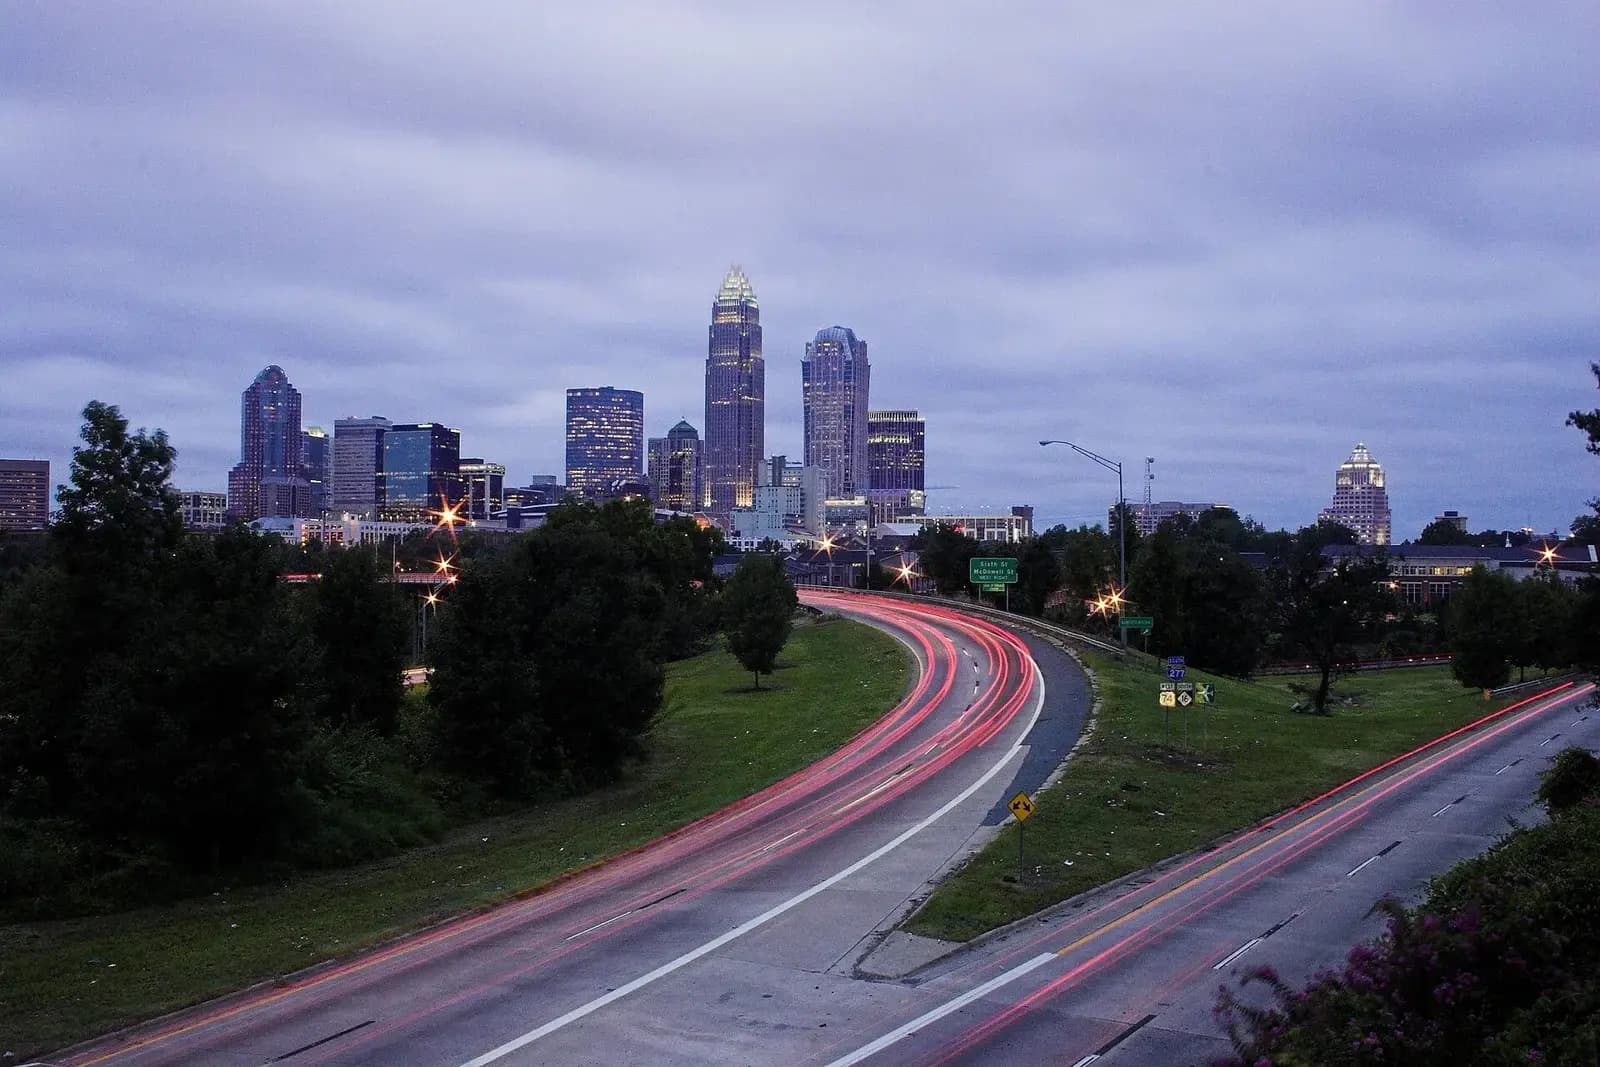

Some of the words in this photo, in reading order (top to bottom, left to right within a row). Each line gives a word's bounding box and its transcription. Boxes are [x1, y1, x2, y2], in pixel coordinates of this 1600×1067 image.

[1169, 669, 1185, 678] 277
[1161, 693, 1173, 703] 74
[1181, 694, 1189, 703] 16
